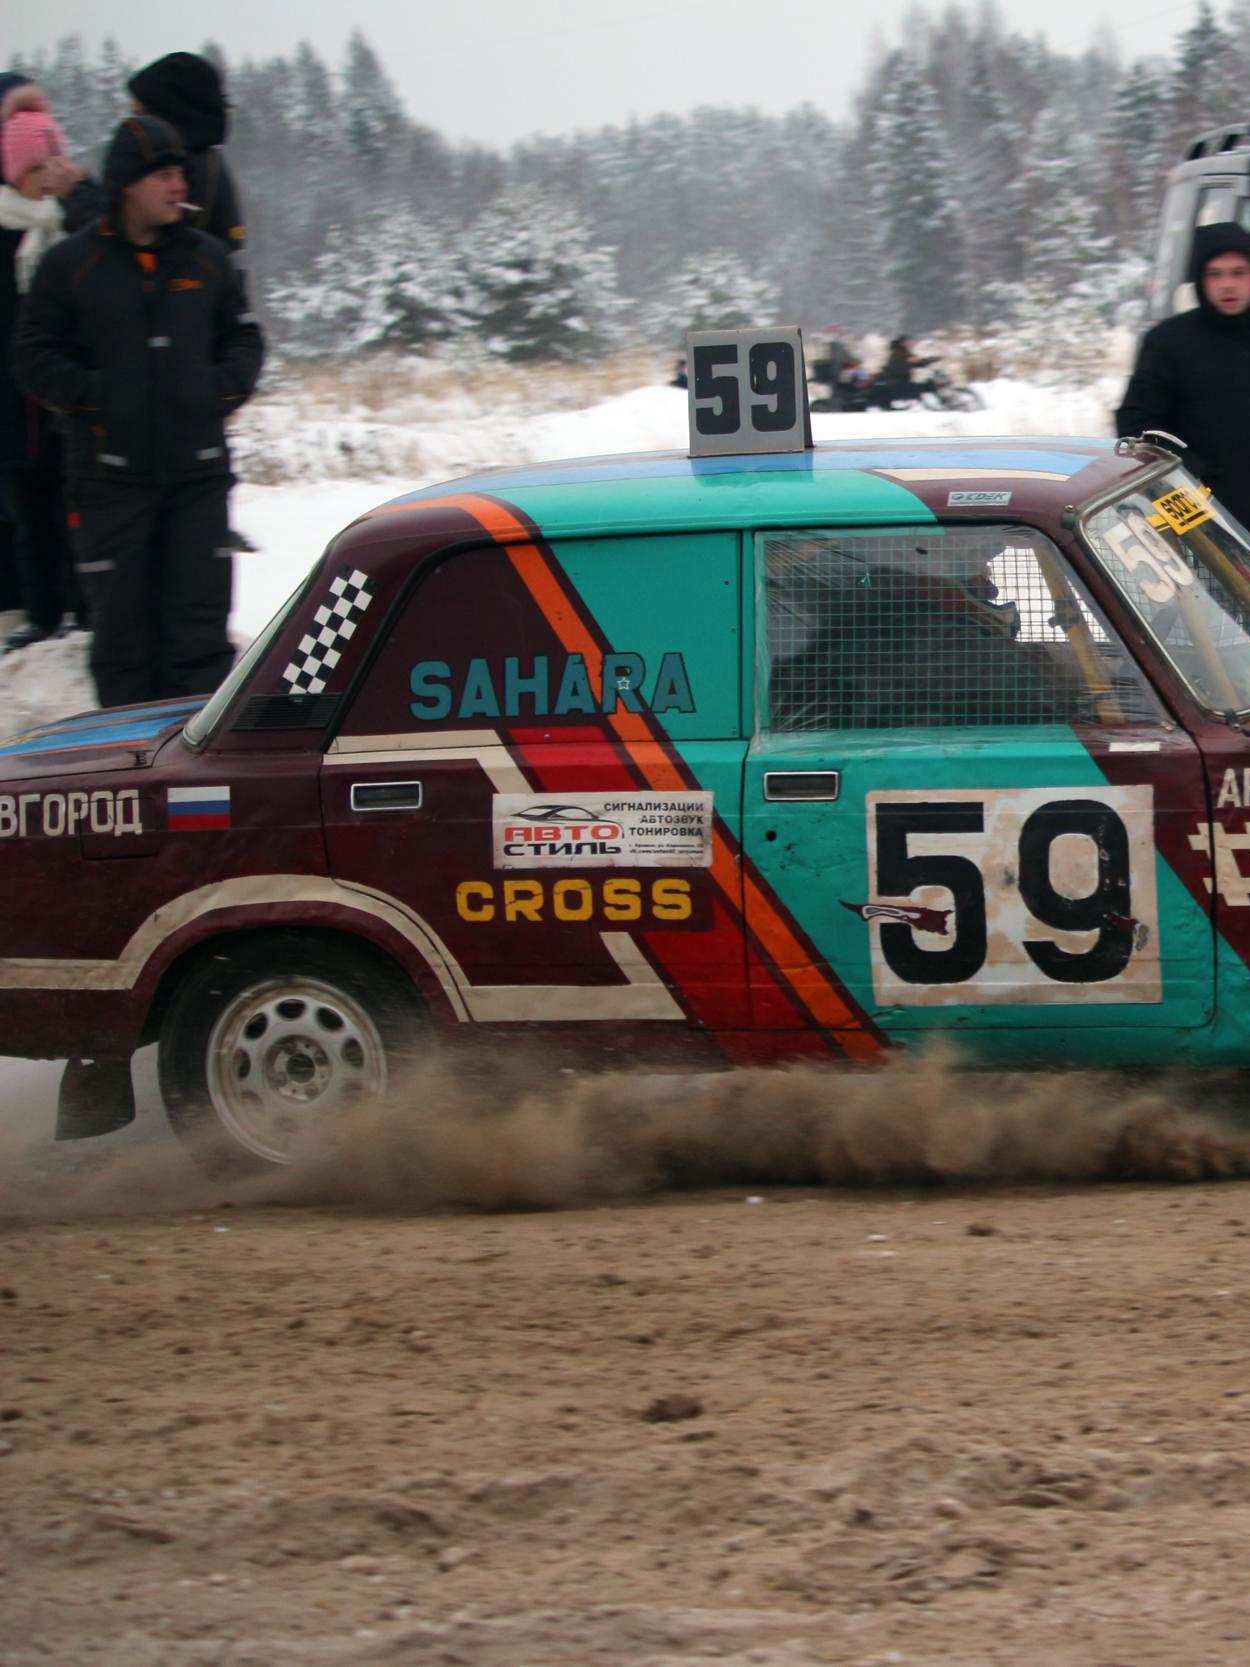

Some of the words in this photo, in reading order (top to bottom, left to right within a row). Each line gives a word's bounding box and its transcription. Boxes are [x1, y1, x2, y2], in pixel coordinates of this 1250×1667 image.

[693, 342, 798, 435] 59
[1103, 511, 1194, 603] 59
[409, 652, 697, 721] SAHARA
[0, 789, 143, 837] ВГОРОД
[603, 802, 704, 813] СИГНАЛИЗАЦИИ
[640, 815, 704, 825] АВТОЗВУК
[503, 842, 622, 856] СТИЛЬ
[504, 825, 620, 842] АВТО
[629, 827, 703, 837] ТОНИРОВКА
[455, 878, 694, 922] CROSS
[876, 800, 1134, 984] 59
